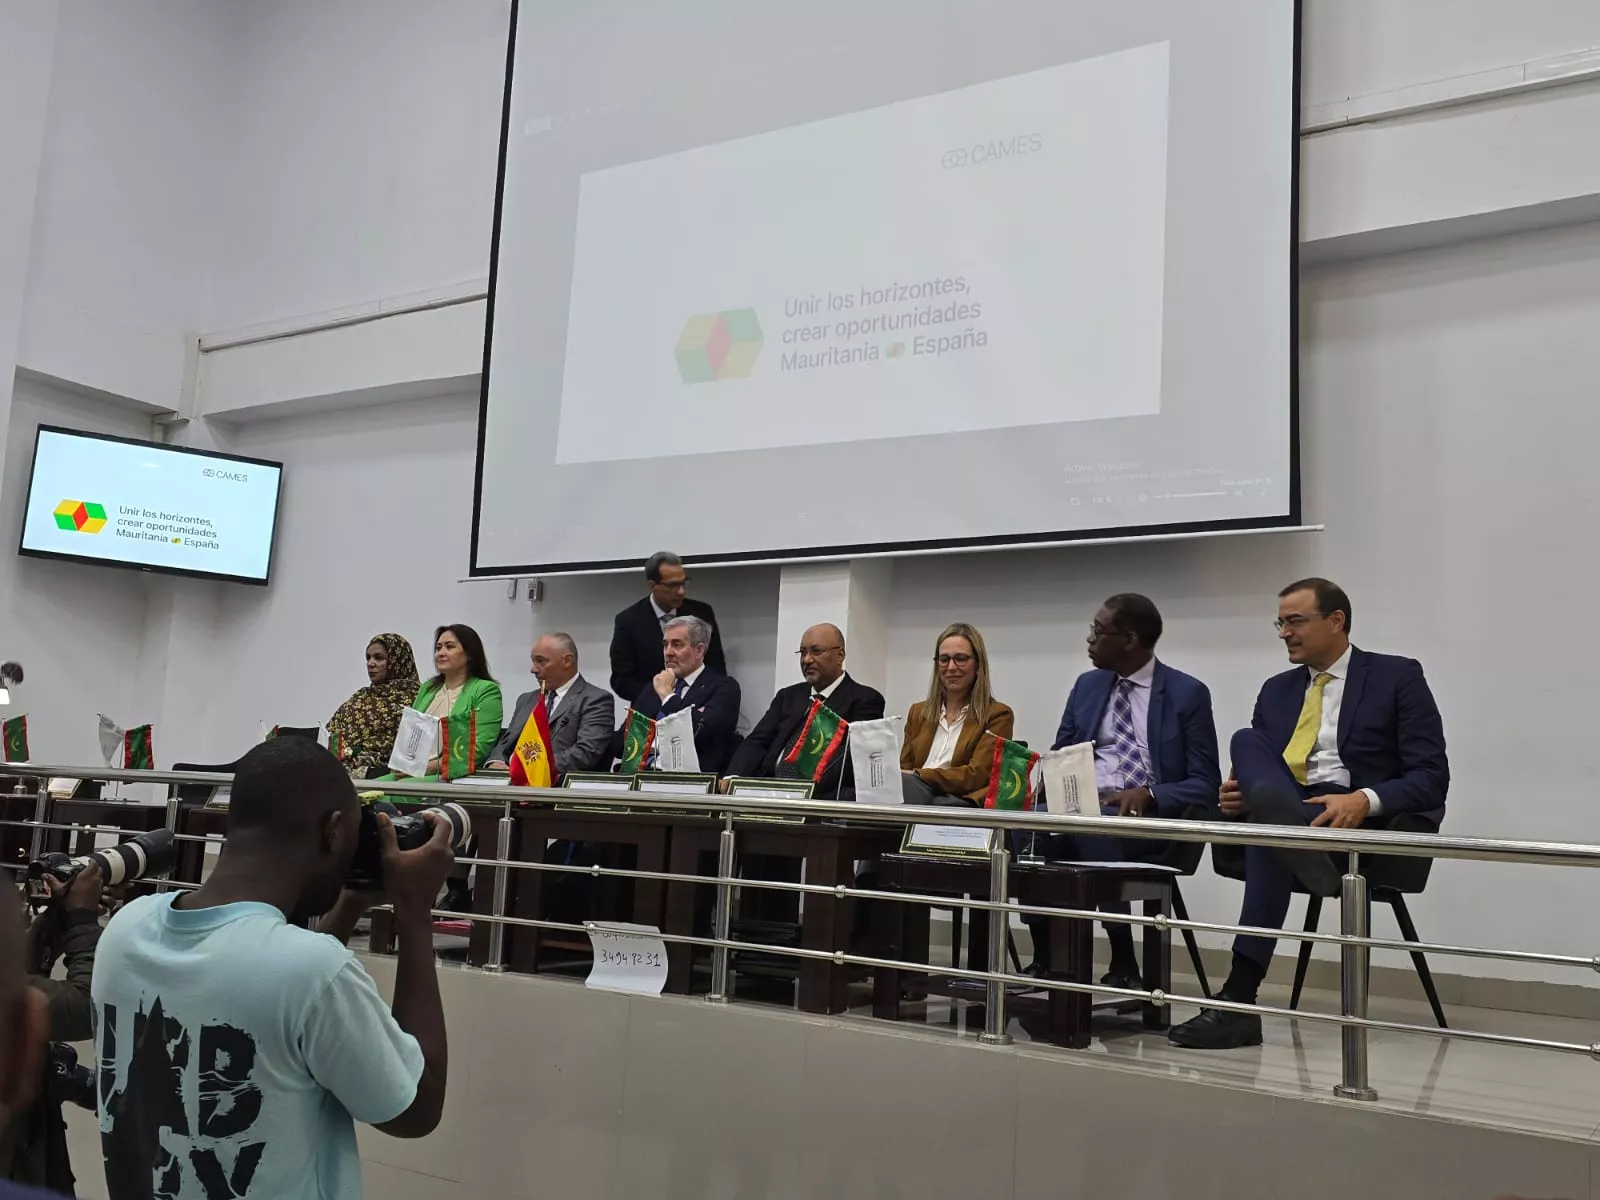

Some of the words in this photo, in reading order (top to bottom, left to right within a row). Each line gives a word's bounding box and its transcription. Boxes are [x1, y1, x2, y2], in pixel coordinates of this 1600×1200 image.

[971, 132, 1042, 164] CAMES
[784, 296, 822, 319] Unir
[827, 292, 855, 312] los
[860, 275, 971, 307] horizontes,
[782, 323, 830, 344] crear
[835, 302, 981, 339] oportunidades
[780, 342, 880, 372] Mauritania
[912, 329, 988, 357] España
[216, 470, 248, 482] CAMES
[117, 518, 144, 528] crear
[146, 522, 217, 538] oportunidades
[119, 505, 140, 516] Unir
[142, 509, 157, 519] los
[160, 512, 213, 528] horizontes,
[116, 528, 168, 543] Mauritania
[184, 537, 219, 550] España
